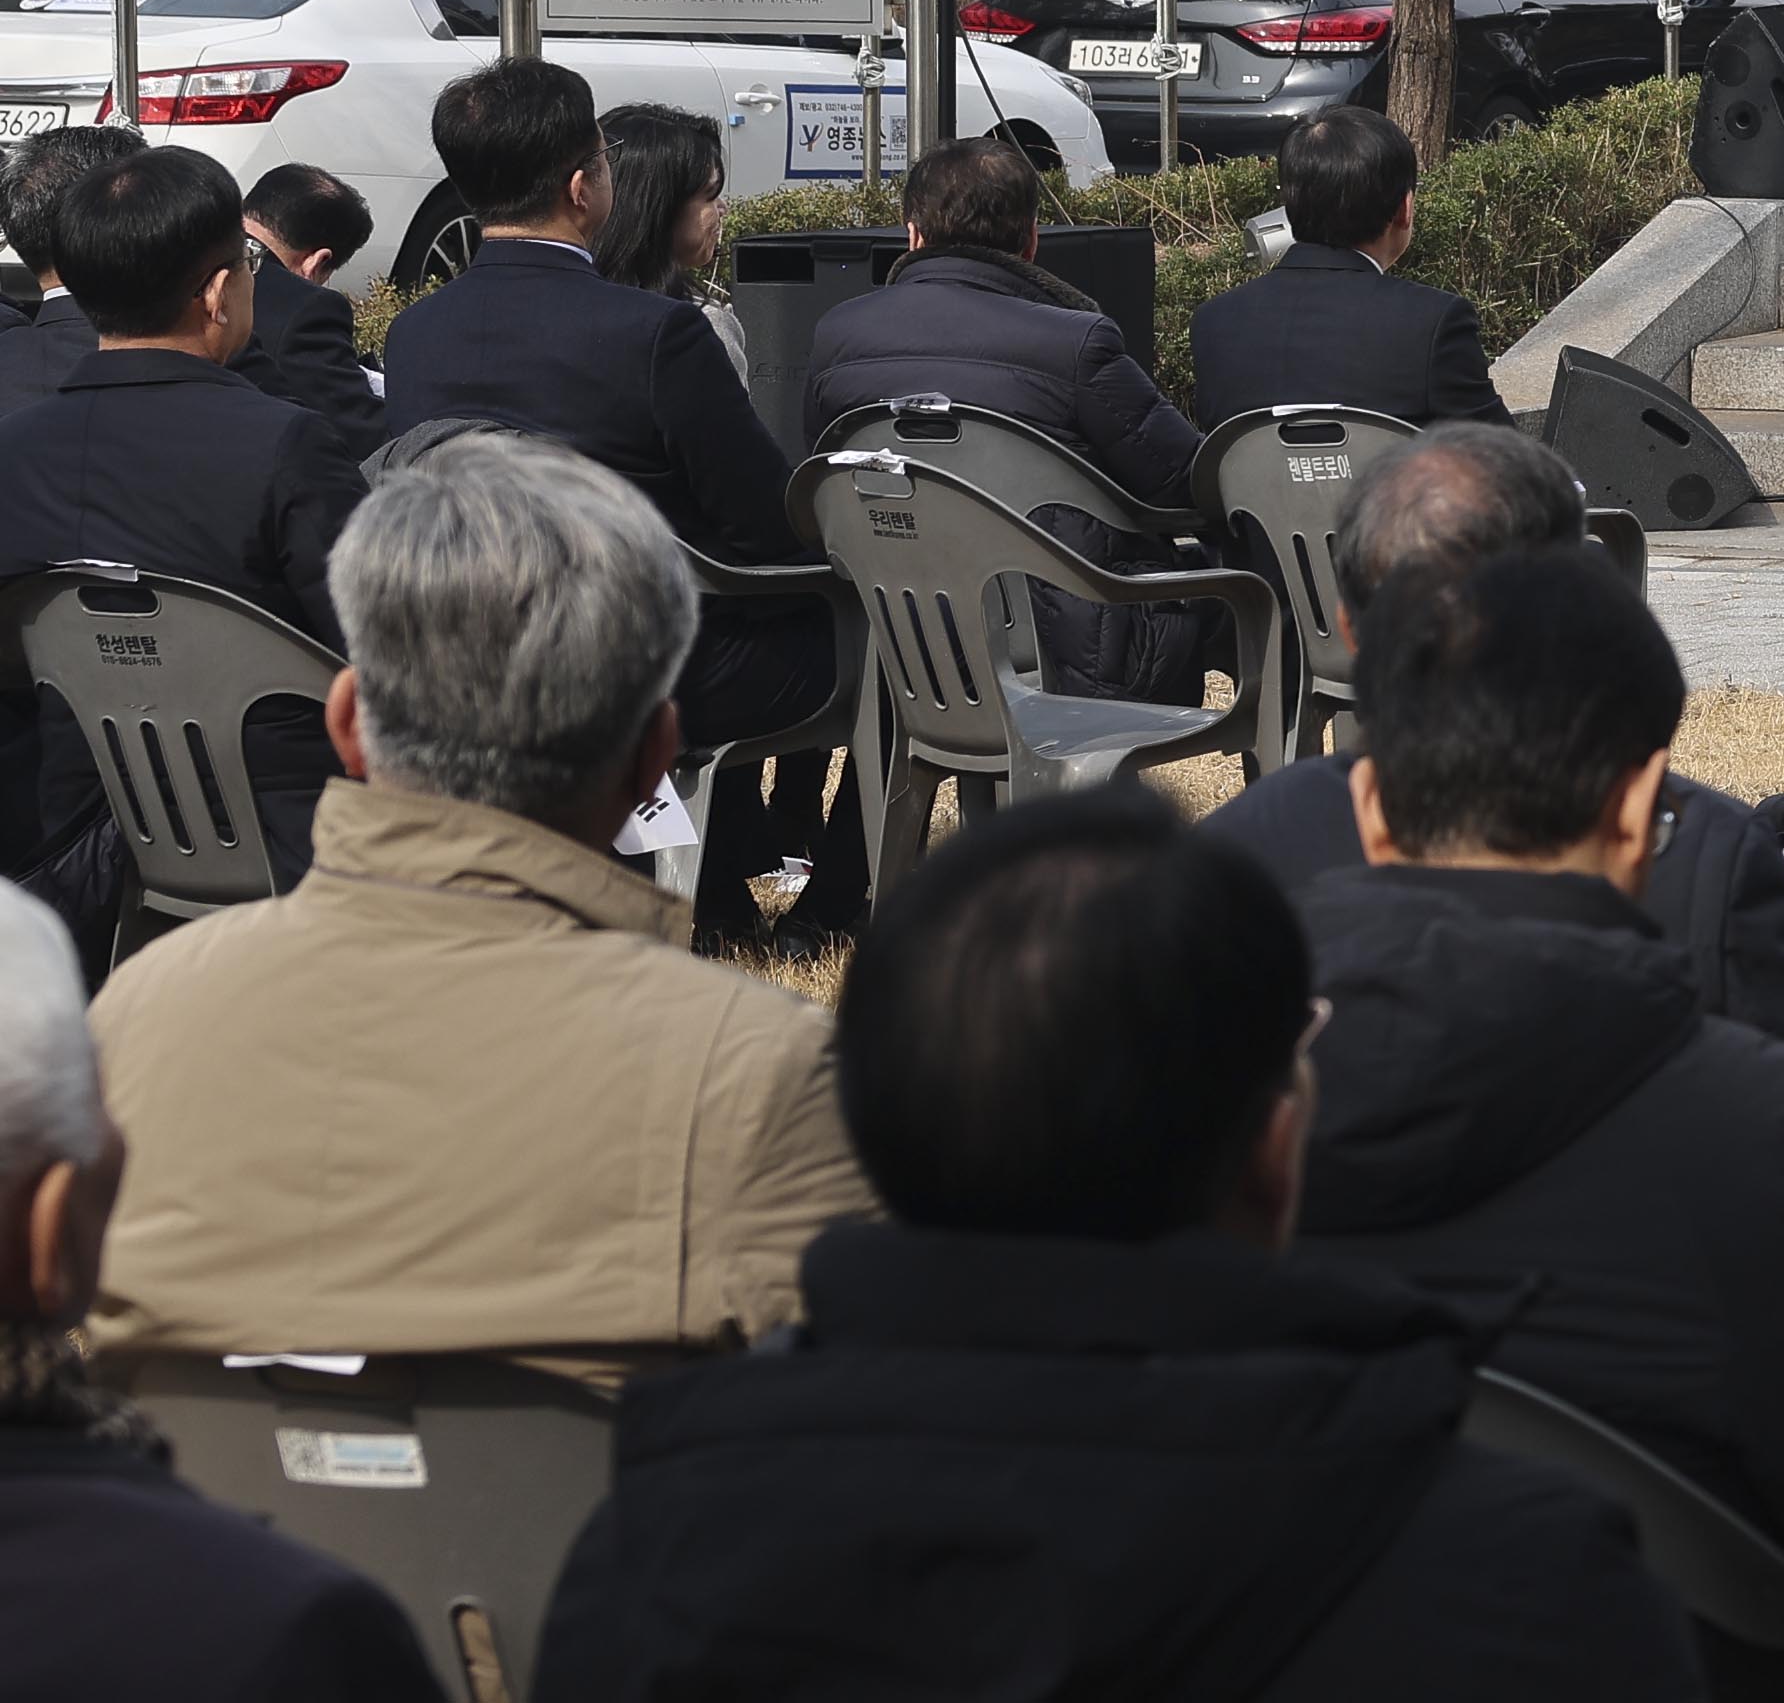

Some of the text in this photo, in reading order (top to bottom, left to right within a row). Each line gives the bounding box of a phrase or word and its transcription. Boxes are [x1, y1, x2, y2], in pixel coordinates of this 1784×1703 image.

[1080, 45, 1132, 66] 103러
[868, 509, 916, 530] 우리렌탈
[95, 634, 158, 655] 한성렌탈
